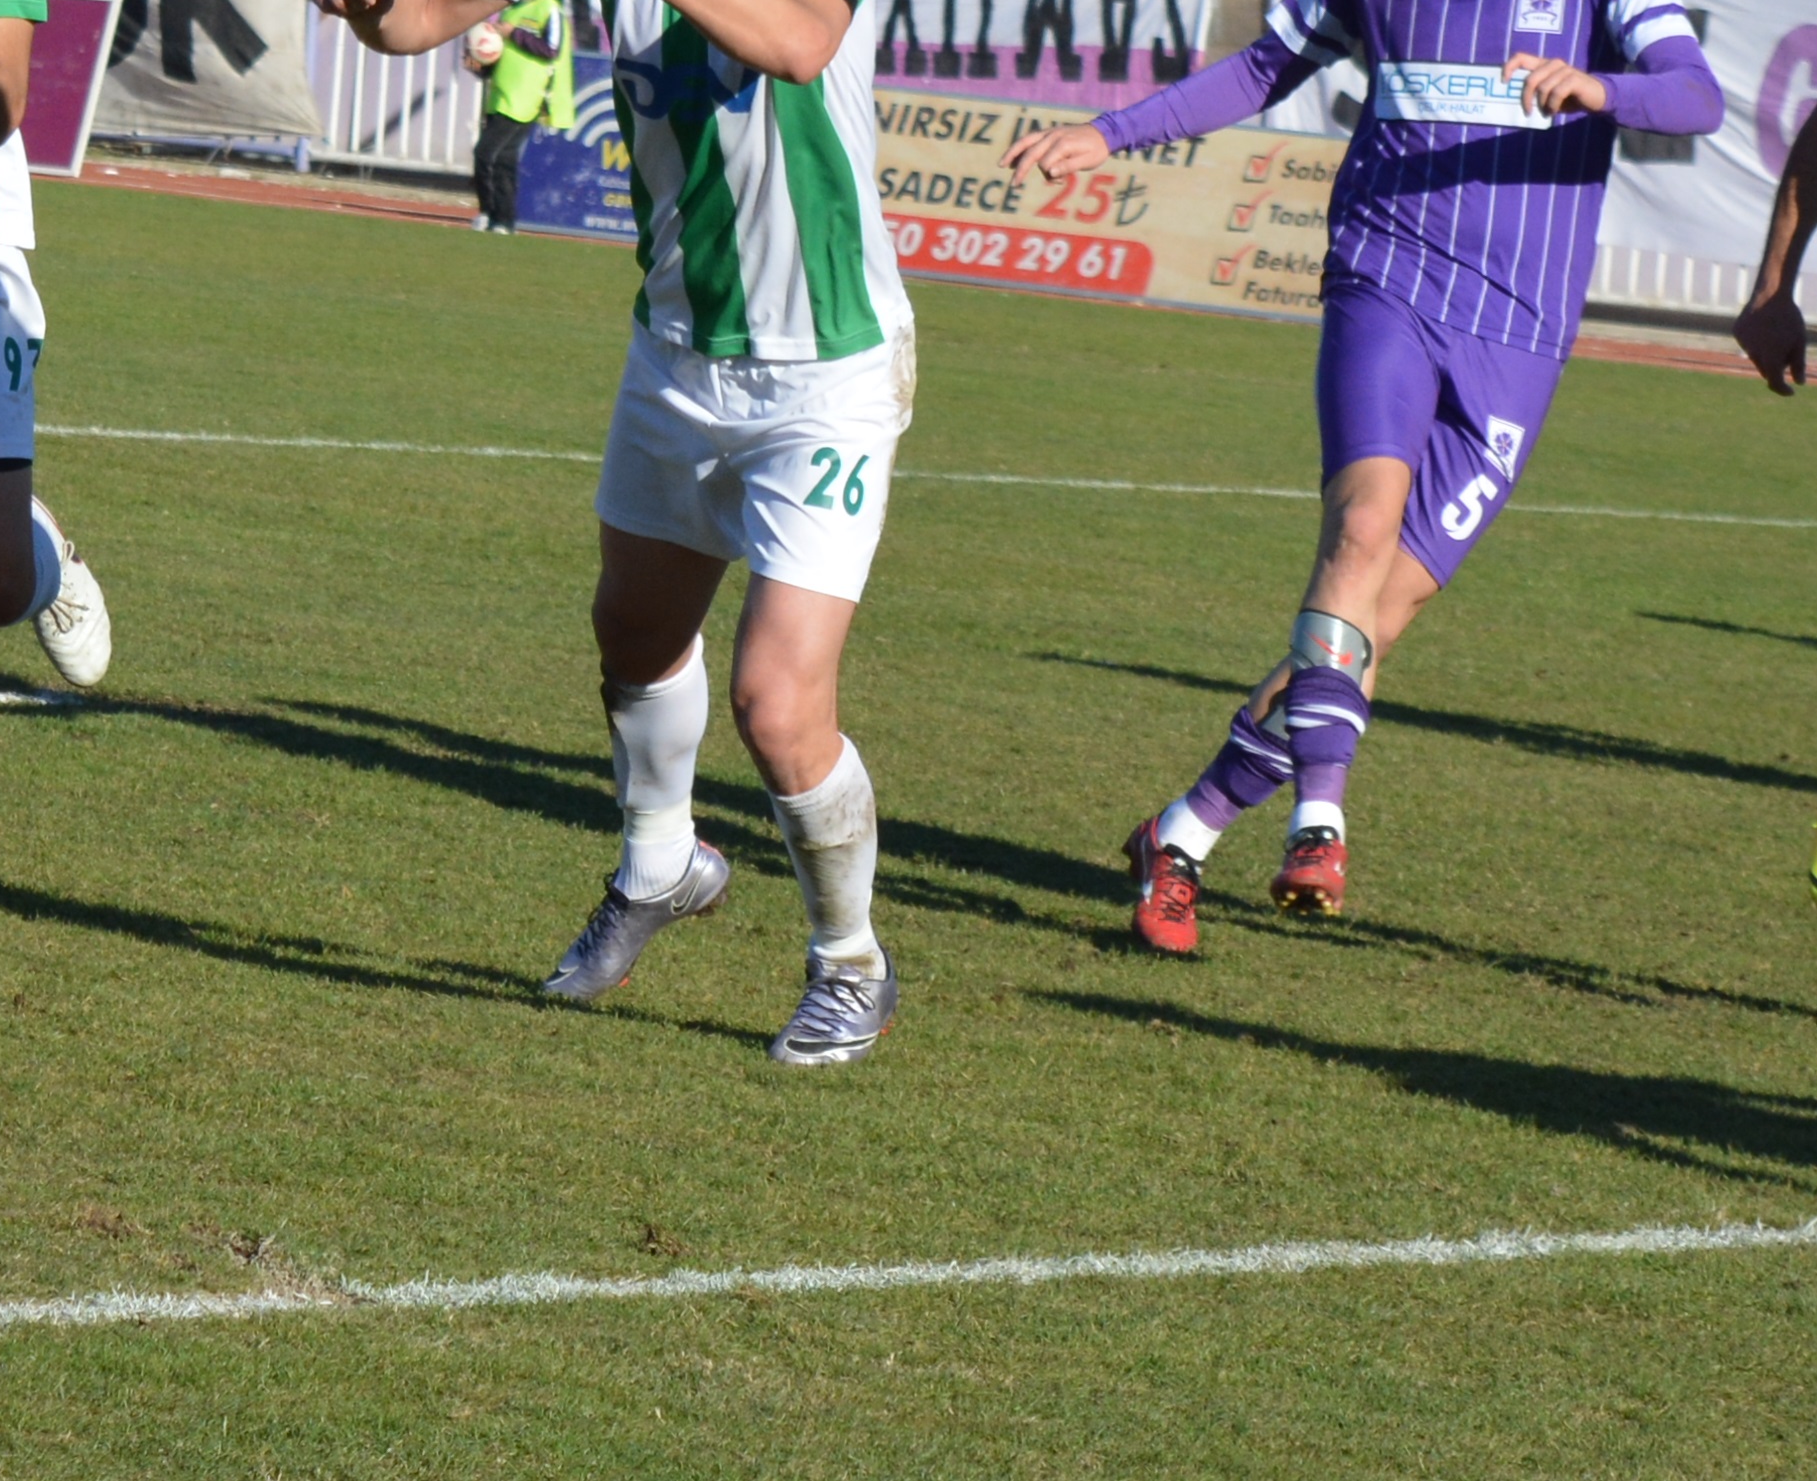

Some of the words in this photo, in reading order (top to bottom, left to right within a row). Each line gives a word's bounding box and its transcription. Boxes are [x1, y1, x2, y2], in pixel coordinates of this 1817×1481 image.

[878, 167, 1026, 214] SADECE
[930, 225, 1010, 267] 302
[1014, 235, 1072, 274] 29
[1077, 242, 1128, 281] 61
[4, 336, 44, 392] 97
[802, 446, 871, 517] 26
[1440, 473, 1499, 541] 5
